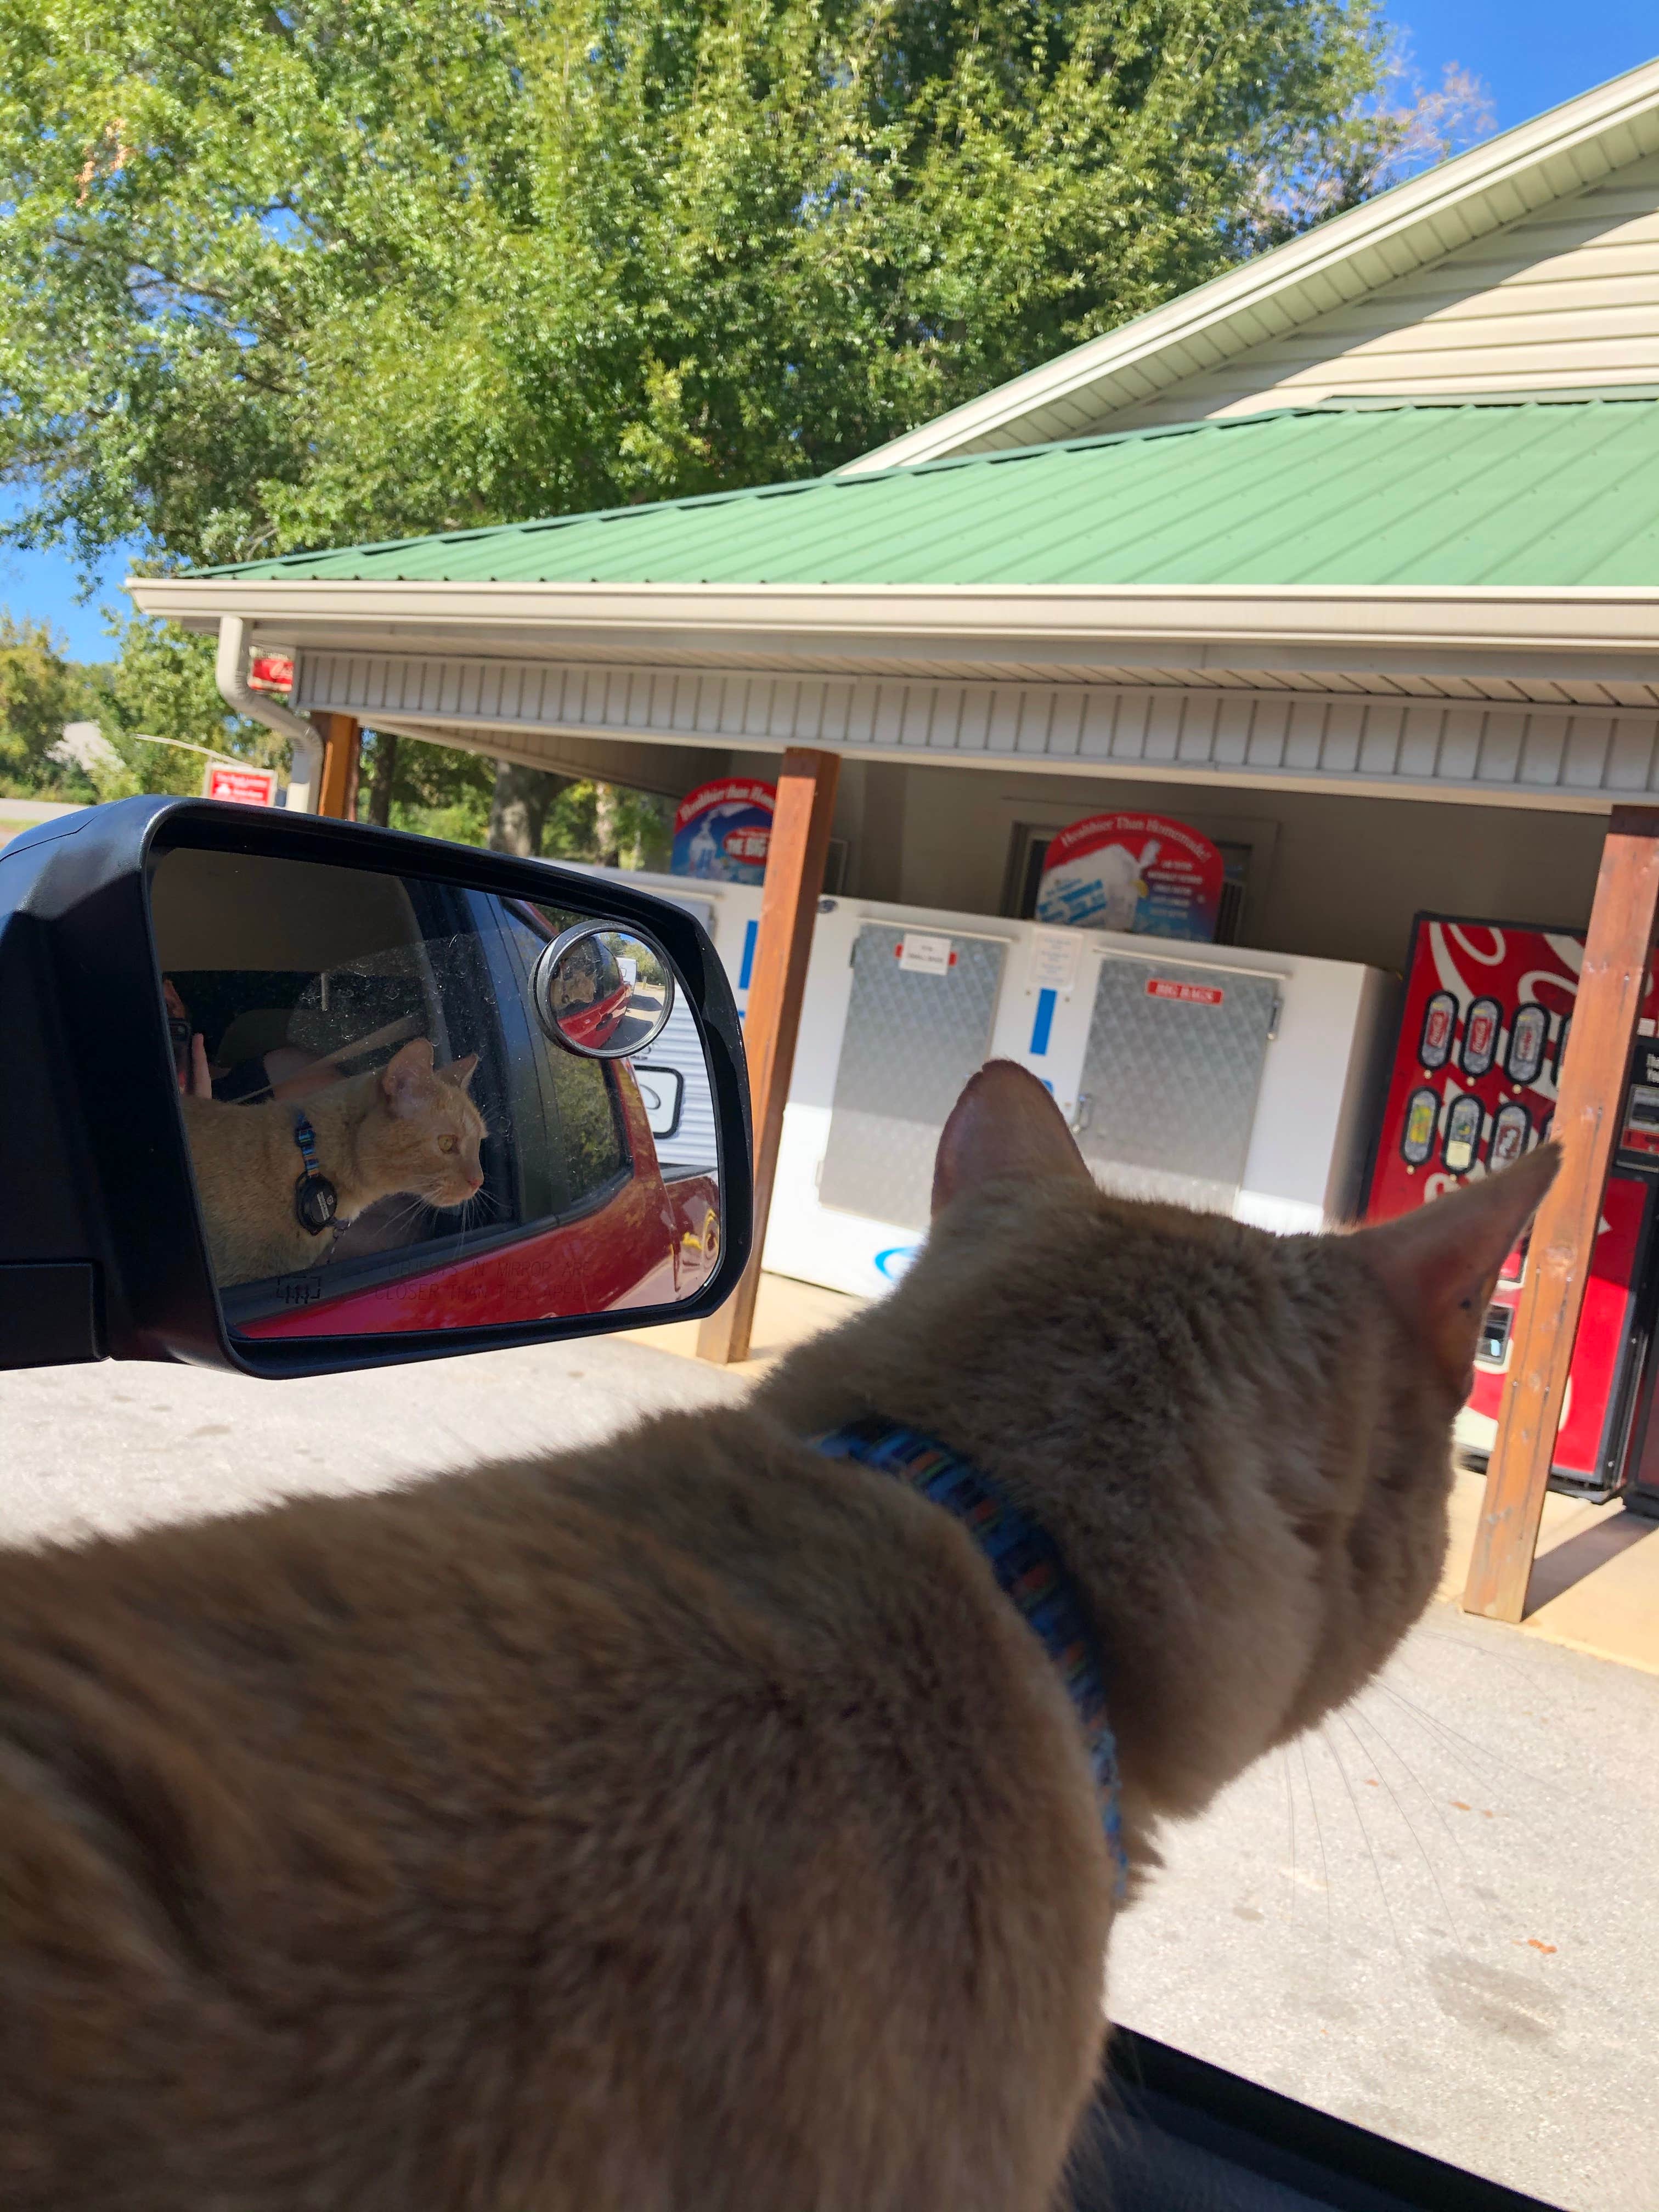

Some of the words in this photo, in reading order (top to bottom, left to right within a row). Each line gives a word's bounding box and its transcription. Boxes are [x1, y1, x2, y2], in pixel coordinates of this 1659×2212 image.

[1156, 983, 1178, 997] BIG
[1179, 985, 1214, 1002] BAGS
[388, 1261, 457, 1277] OBJECTS
[472, 1261, 485, 1277] IN
[497, 1261, 552, 1277] MIRROR
[562, 1261, 590, 1277] ARE
[375, 1284, 440, 1300] CLOSER
[448, 1284, 487, 1300] THAN
[497, 1284, 535, 1300] THEY
